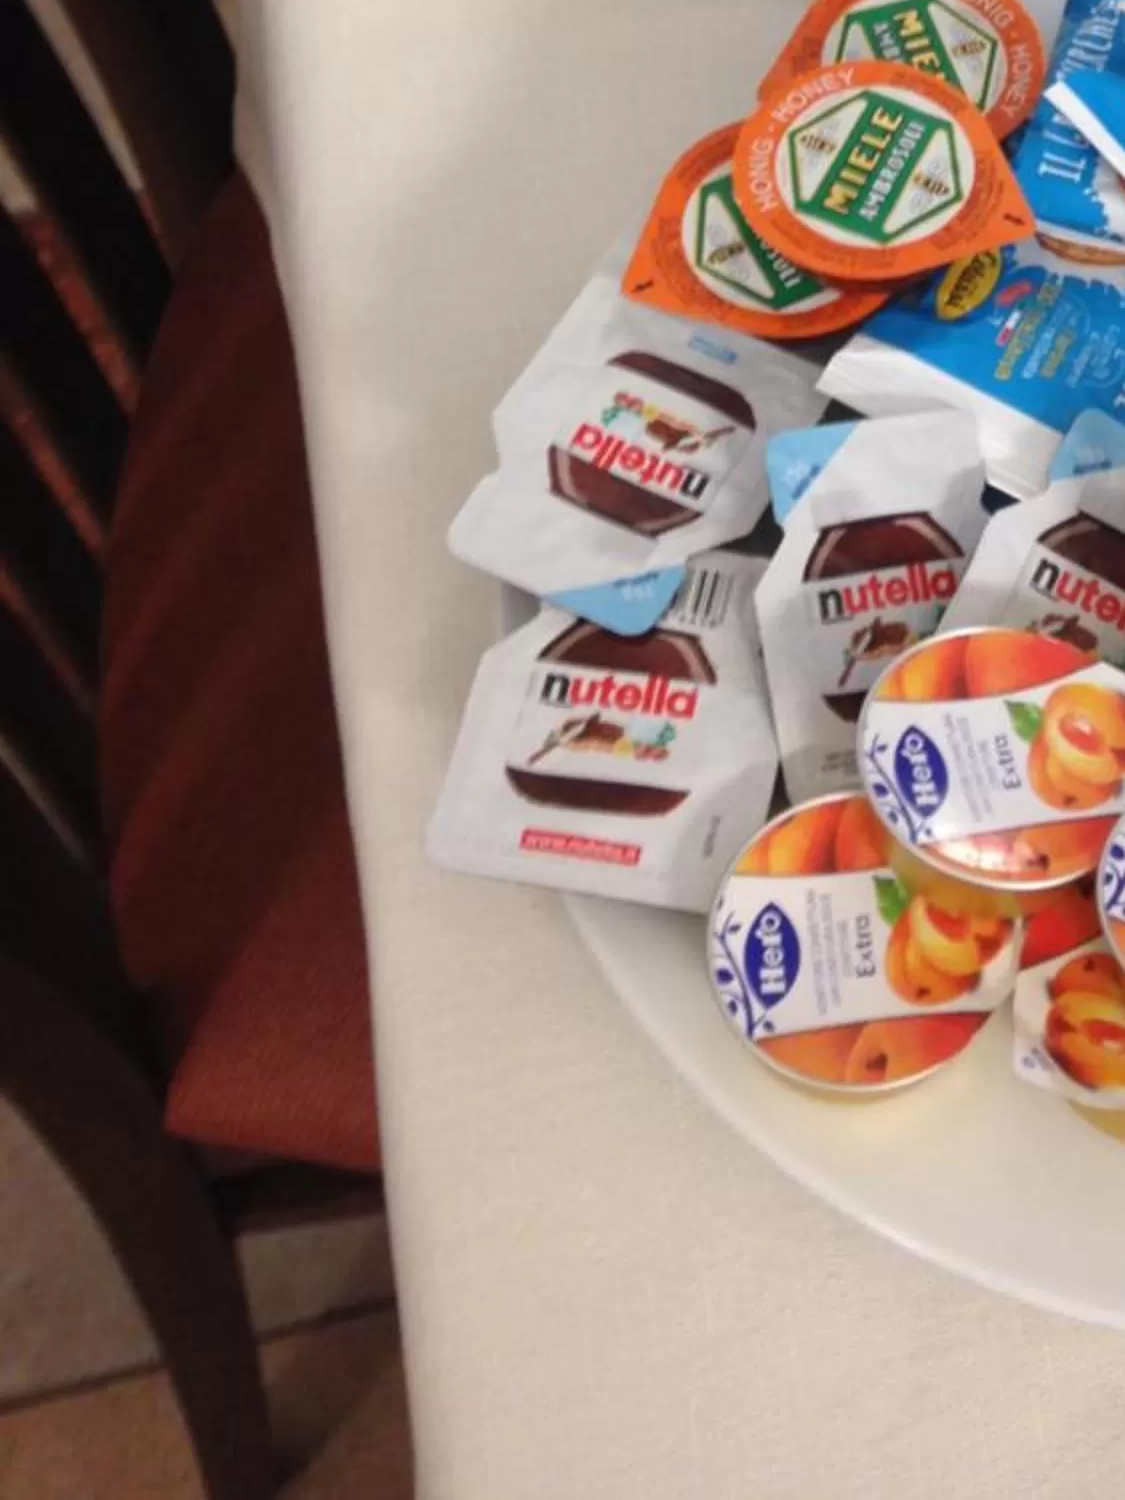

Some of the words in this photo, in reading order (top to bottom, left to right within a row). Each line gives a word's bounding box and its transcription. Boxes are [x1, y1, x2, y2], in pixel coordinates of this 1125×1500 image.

[1002, 45, 1034, 119] HONEY
[748, 136, 778, 213] HONIG
[770, 67, 856, 123] HONEY
[823, 105, 904, 215] MIELE
[571, 421, 712, 500] nutella
[817, 562, 959, 625] nutella
[540, 668, 698, 720] nutella
[901, 733, 940, 816] Hero
[994, 733, 1022, 791] Extra
[755, 910, 787, 997] Hero
[855, 914, 877, 979] Extra
